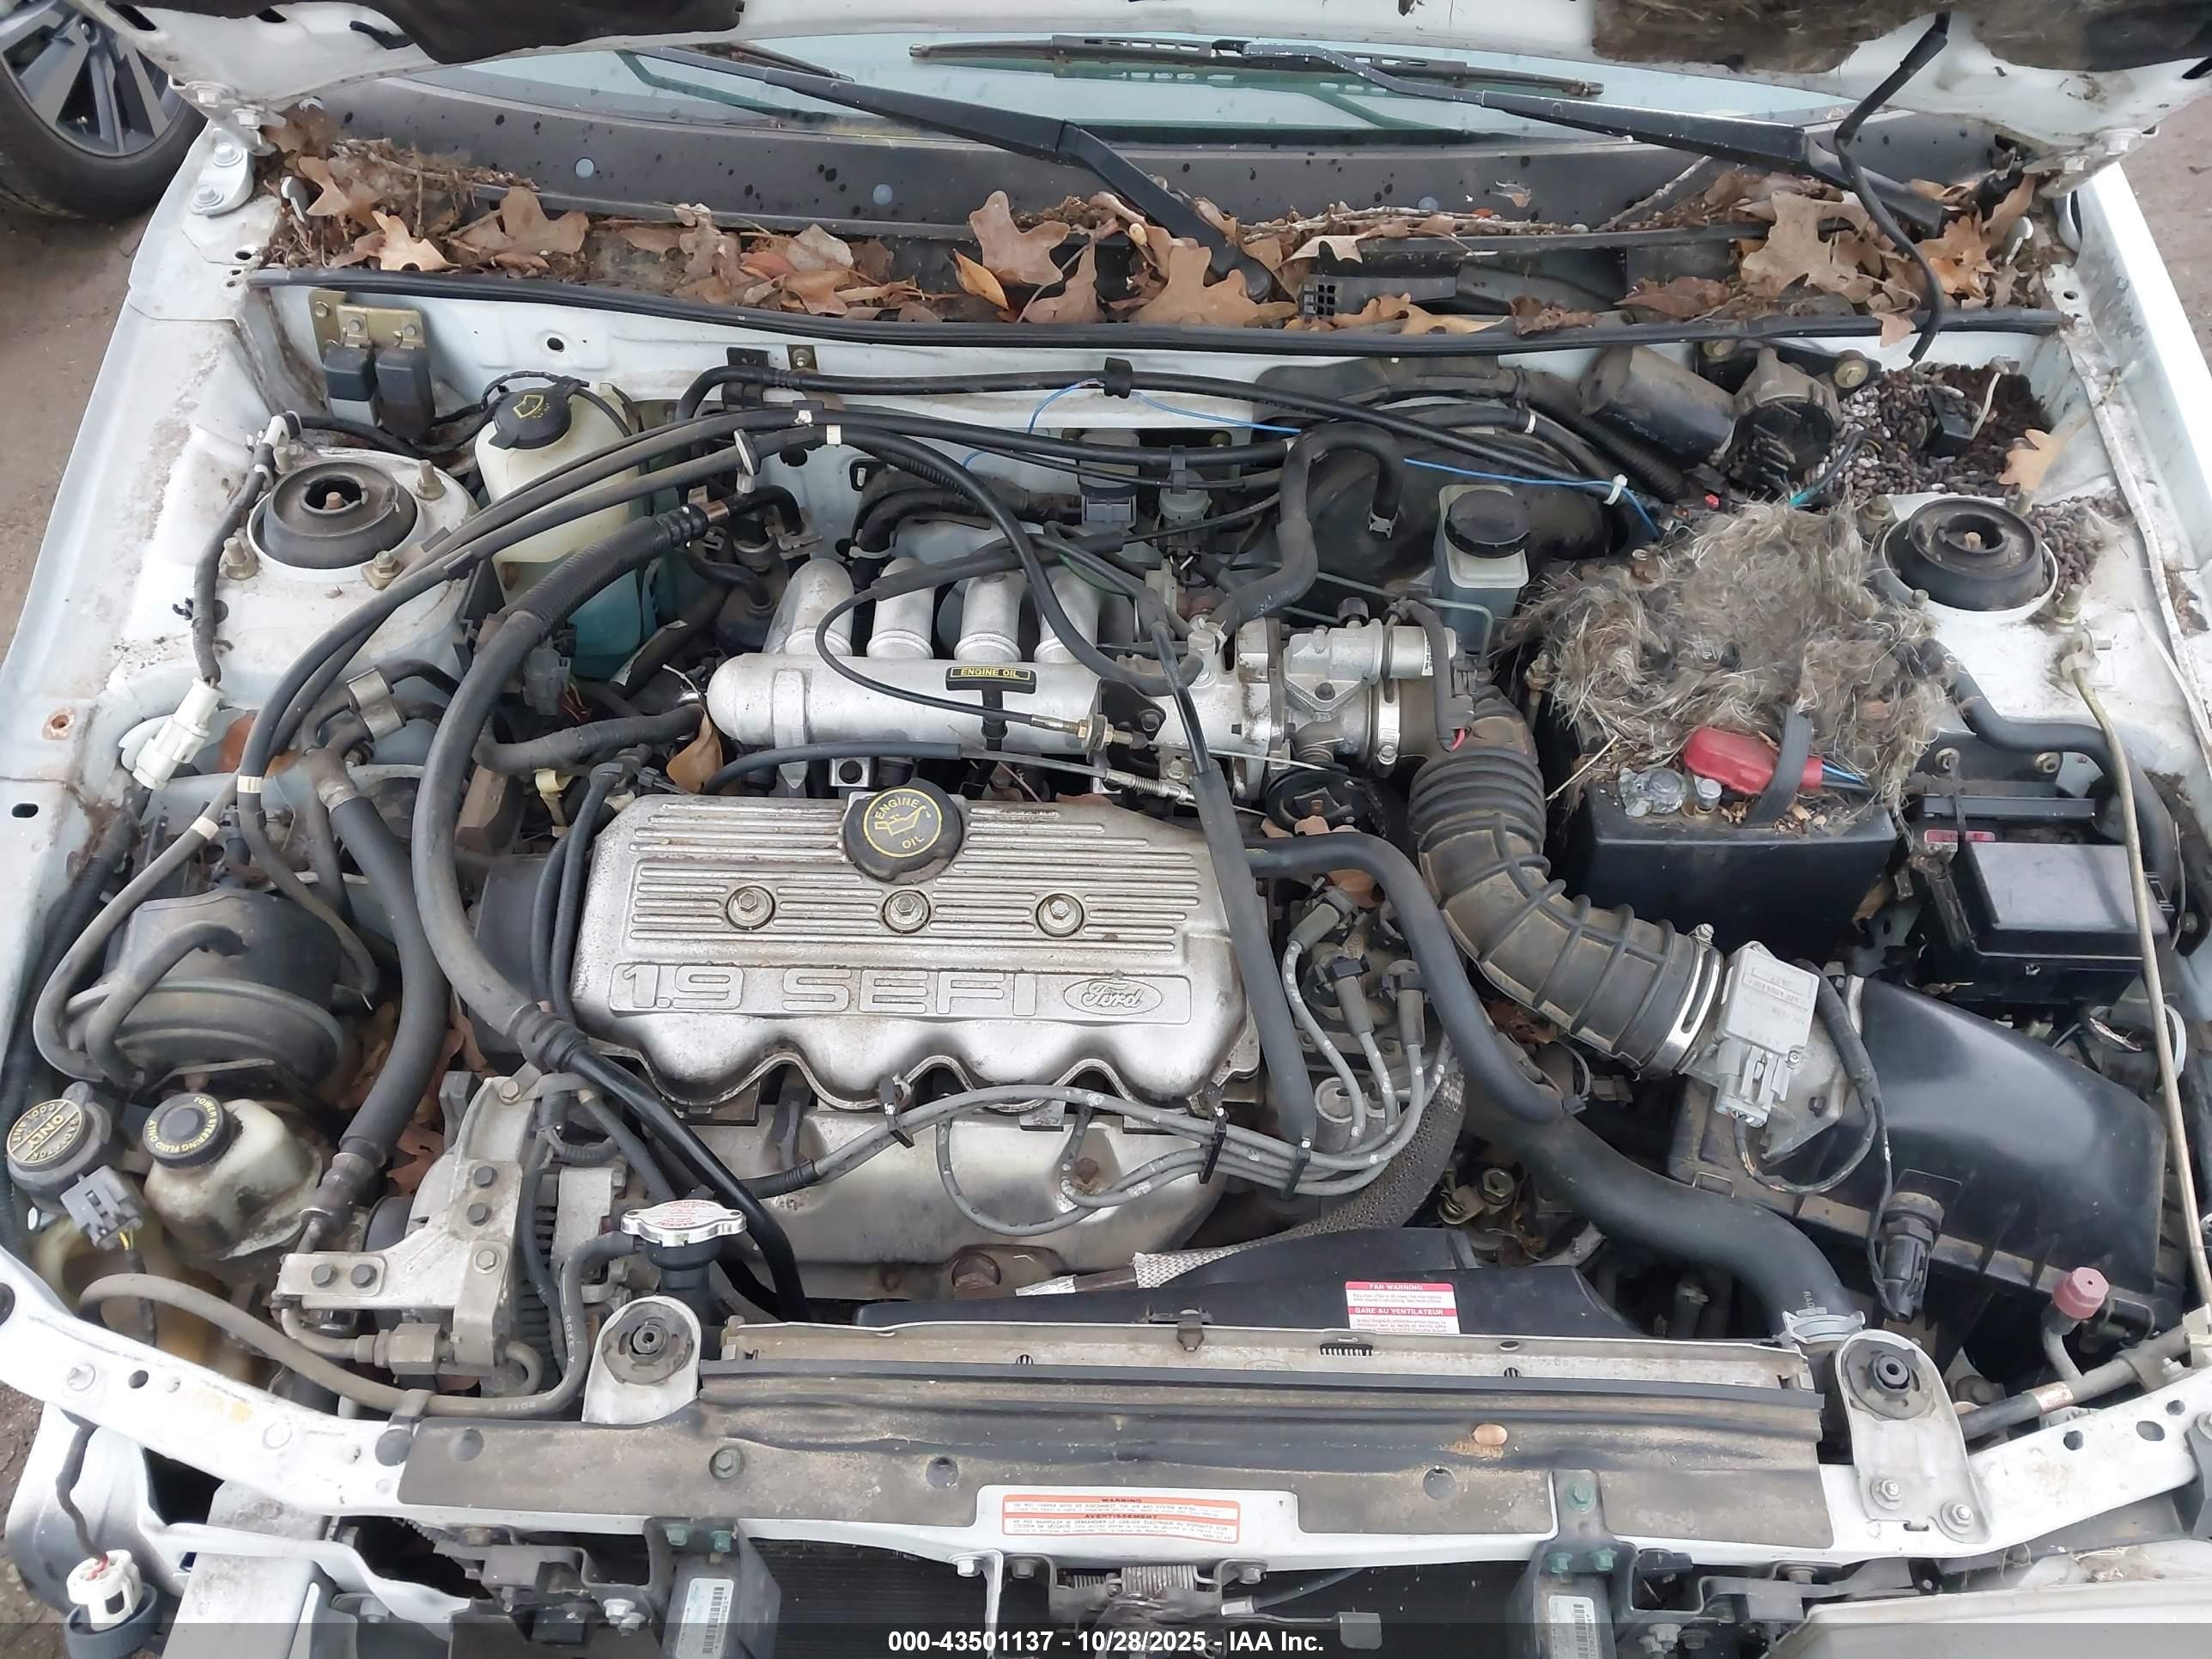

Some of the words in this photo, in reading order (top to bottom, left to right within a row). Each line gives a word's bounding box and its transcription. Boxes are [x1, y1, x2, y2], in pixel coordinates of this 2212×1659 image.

[874, 797, 921, 820] ENGINE
[902, 836, 925, 849] OIL
[622, 963, 744, 1009] 1.9
[781, 968, 1036, 1016] SEFI
[1079, 980, 1146, 1010] Ford
[193, 1097, 217, 1118] POWER
[12, 1103, 55, 1144] COOLANT
[27, 1115, 64, 1150] ONLY
[147, 1120, 159, 1142] ONLY
[32, 1117, 78, 1161] RADIATOR
[155, 1138, 179, 1154] FLUID
